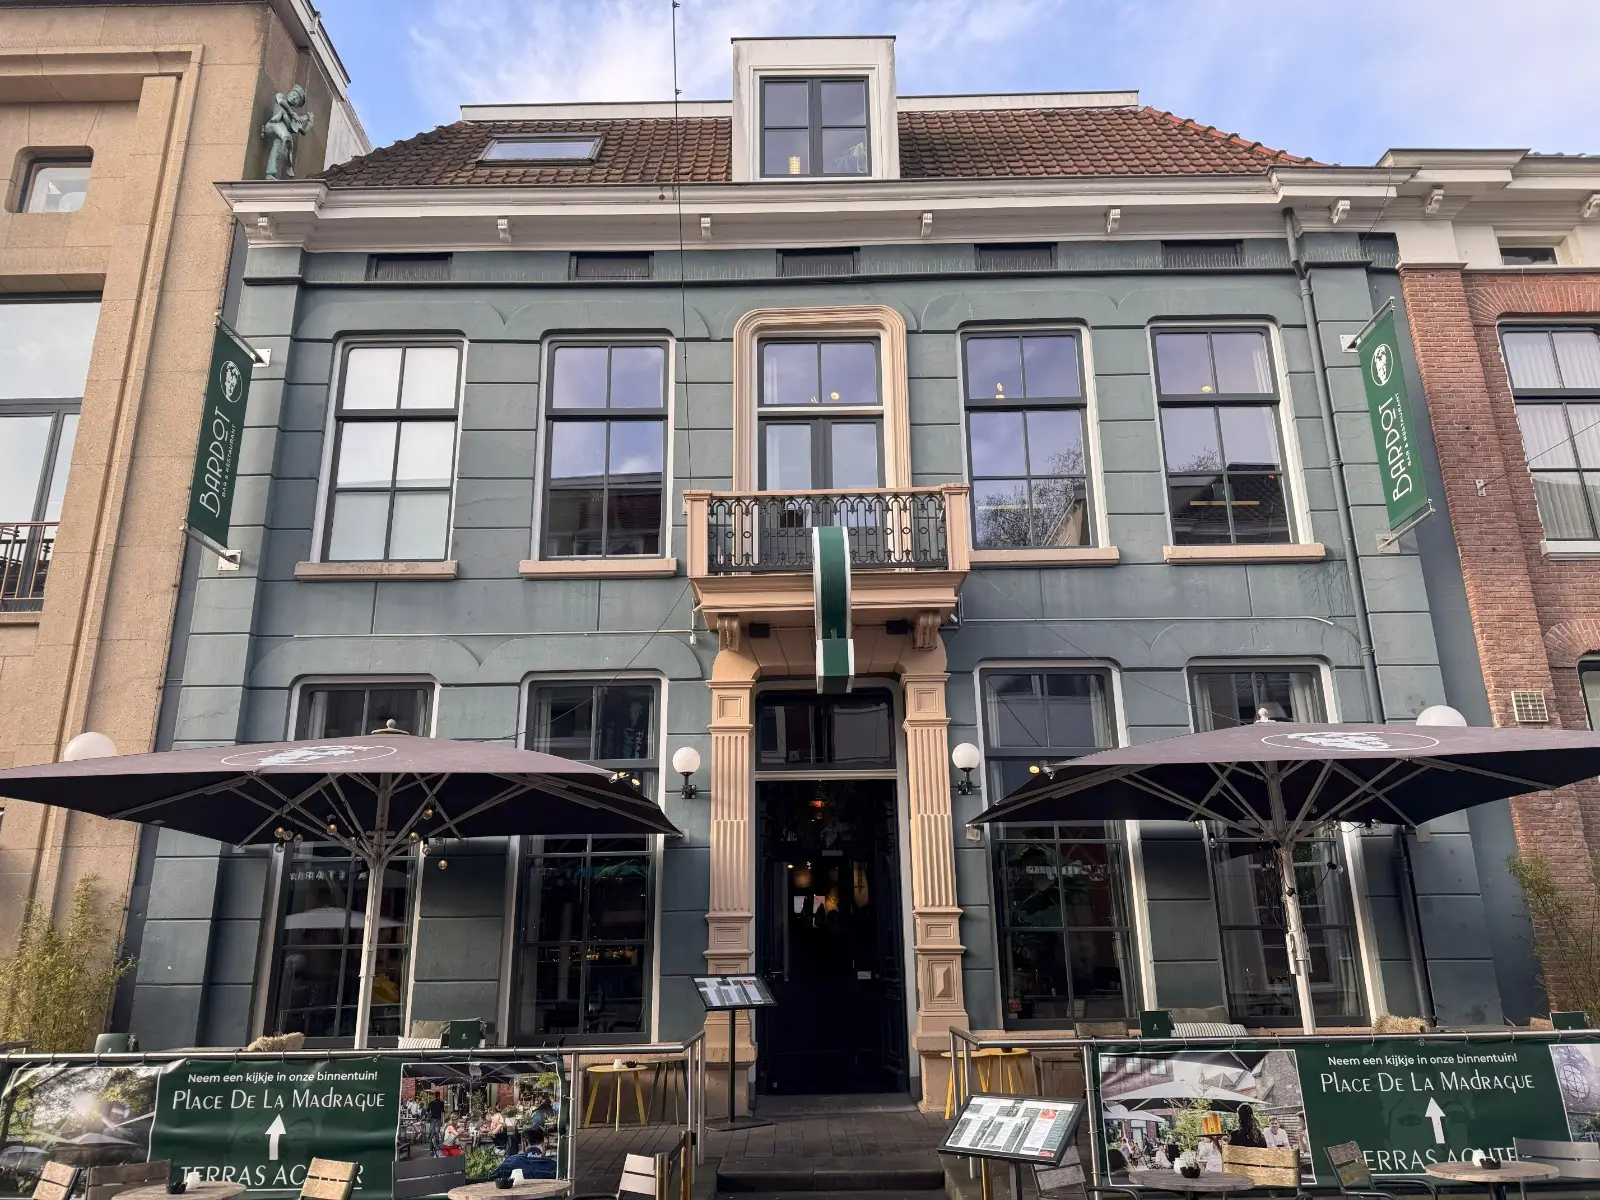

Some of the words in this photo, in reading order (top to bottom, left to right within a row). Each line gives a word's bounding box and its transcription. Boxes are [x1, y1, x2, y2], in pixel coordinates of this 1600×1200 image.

[1394, 392, 1408, 442] RESTAURANT
[199, 405, 230, 518] BARDOT
[225, 424, 237, 473] RESTAURANT
[1378, 396, 1413, 502] BARDOT
[187, 1073, 220, 1083] Neem
[222, 1074, 243, 1082] een
[246, 1071, 274, 1084] kijkje
[276, 1071, 287, 1082] in
[288, 1073, 315, 1082] onze
[316, 1070, 378, 1081] binnentuin!
[1327, 1056, 1360, 1066] Neem
[1362, 1057, 1383, 1065] een
[1384, 1055, 1414, 1067] kijkje
[1416, 1054, 1427, 1065] in
[1429, 1055, 1454, 1064] onze
[1456, 1052, 1518, 1064] binnentuin!
[1362, 1148, 1438, 1171] ERRAS
